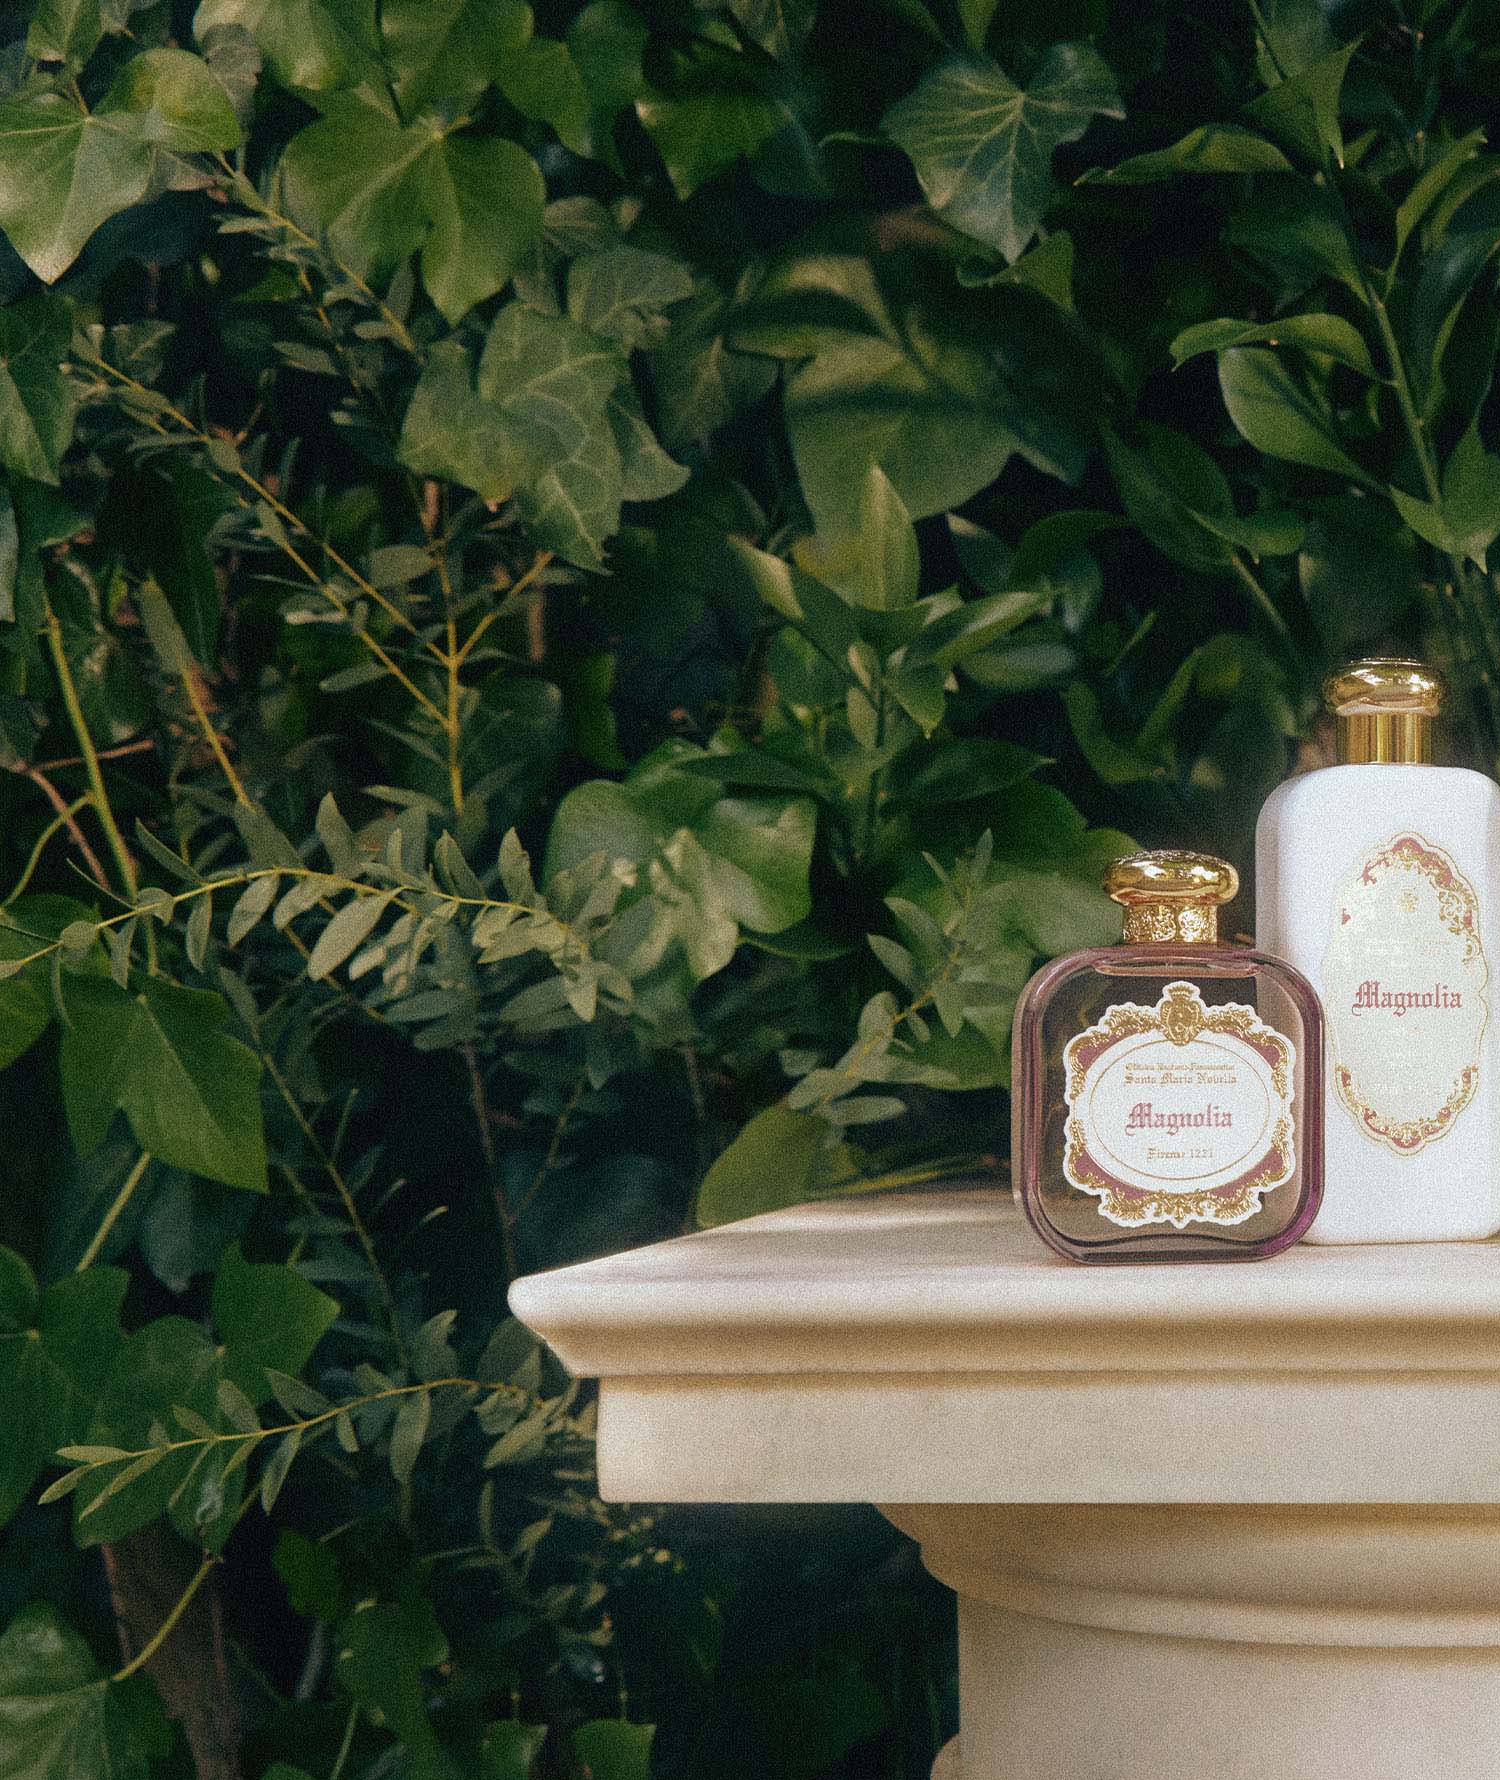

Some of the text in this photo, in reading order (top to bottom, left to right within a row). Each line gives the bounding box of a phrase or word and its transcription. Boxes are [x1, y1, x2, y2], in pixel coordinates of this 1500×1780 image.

[1351, 980, 1462, 1017] Magnolia
[1124, 1073, 1156, 1084] Santa
[1160, 1072, 1192, 1086] Maria
[1125, 1102, 1232, 1136] Magnolia
